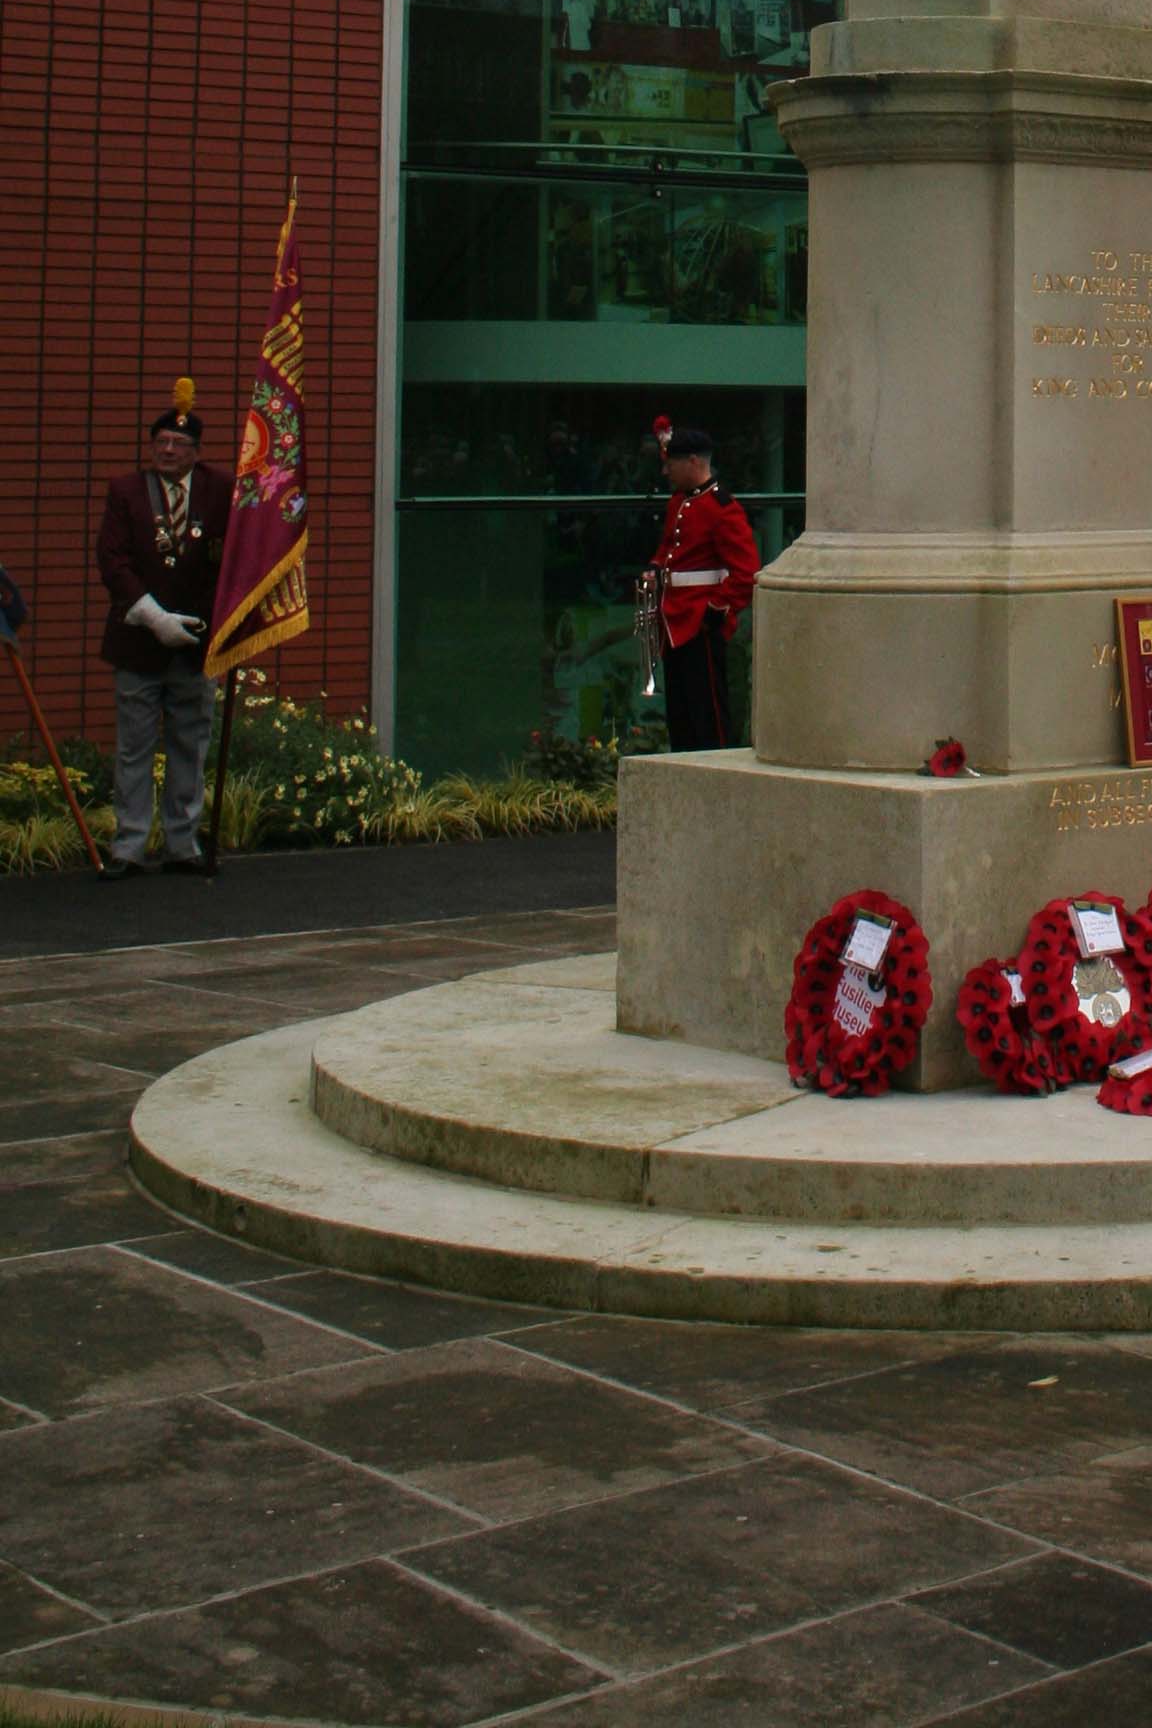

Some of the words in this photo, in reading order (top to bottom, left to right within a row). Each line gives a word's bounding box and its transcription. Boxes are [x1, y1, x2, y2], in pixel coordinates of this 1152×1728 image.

[1091, 250, 1119, 271] TO
[1032, 273, 1138, 296] LANCASHIRE
[1102, 302, 1151, 322] THEIR
[1091, 327, 1130, 347] AND
[1112, 353, 1144, 373] FOR
[1032, 378, 1078, 399] KING
[1088, 379, 1128, 399] AND
[1050, 783, 1096, 808] AND
[1101, 780, 1136, 802] ALL
[1057, 809, 1080, 831] IN
